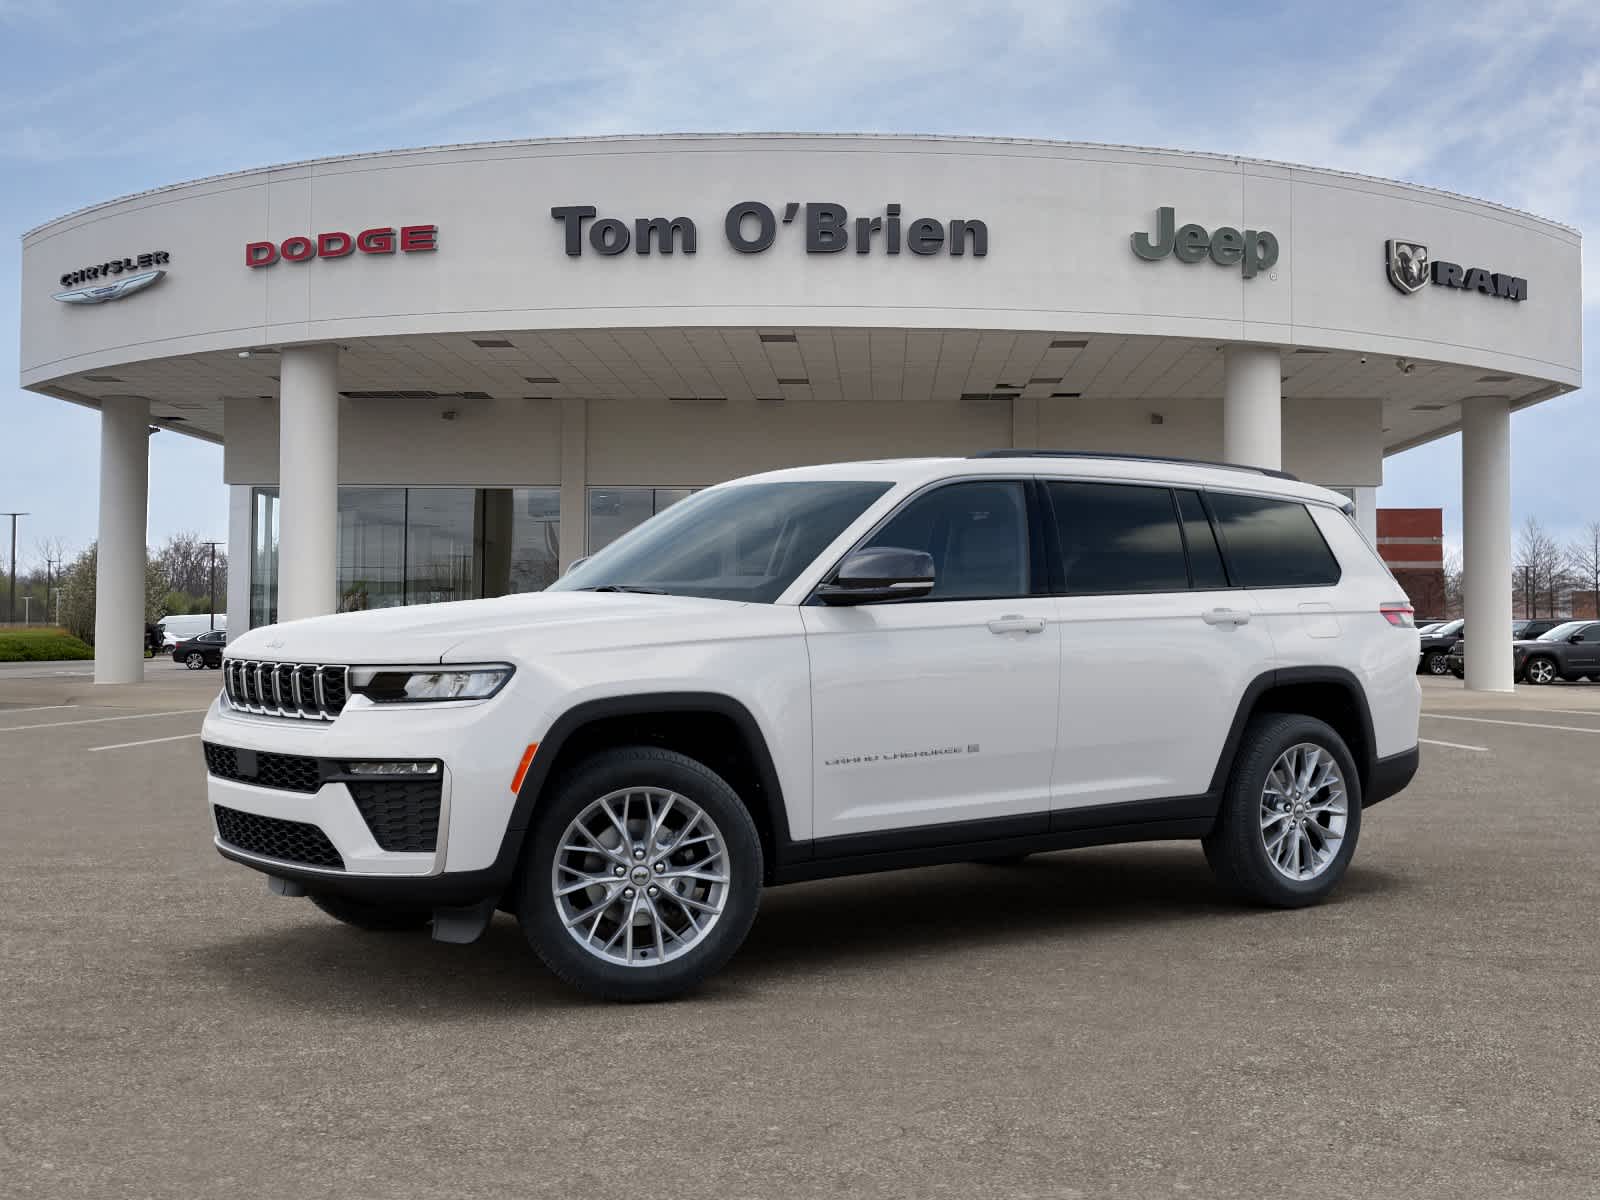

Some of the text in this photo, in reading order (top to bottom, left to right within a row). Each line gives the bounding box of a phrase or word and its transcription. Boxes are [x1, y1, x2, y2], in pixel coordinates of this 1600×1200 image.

[245, 225, 438, 268] DODGE
[552, 201, 988, 256] Tom O'Brien
[1130, 207, 1279, 279] Jeep
[60, 250, 170, 287] CHRYSLER
[1431, 261, 1528, 302] RAM
